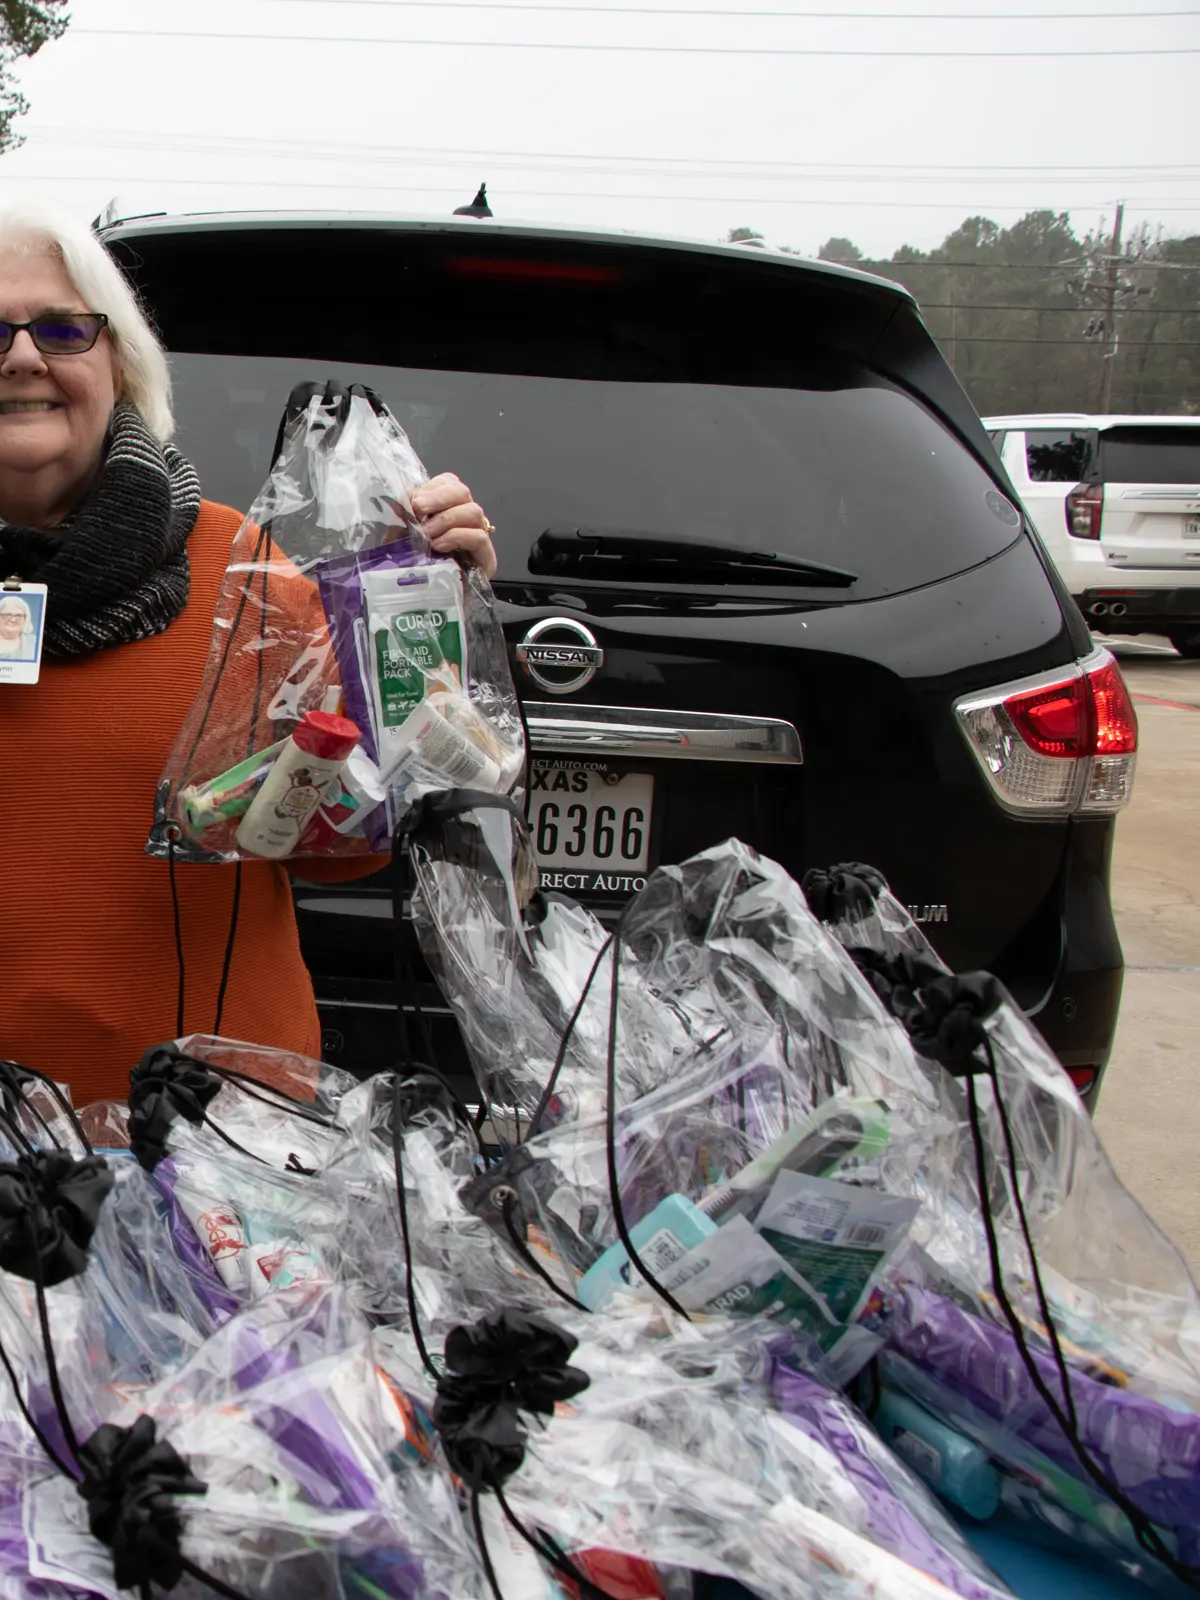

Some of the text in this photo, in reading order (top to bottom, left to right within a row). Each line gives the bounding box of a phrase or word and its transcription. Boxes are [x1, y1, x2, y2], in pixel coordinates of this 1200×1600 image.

[396, 612, 442, 632] CURAD
[383, 646, 428, 661] FIRST AID
[526, 649, 595, 663] NISSAN
[383, 655, 433, 670] PORTABLE
[384, 668, 411, 679] PACK
[531, 760, 550, 769] ECT
[531, 770, 588, 793] XAS
[540, 873, 647, 891] RECT AUTO
